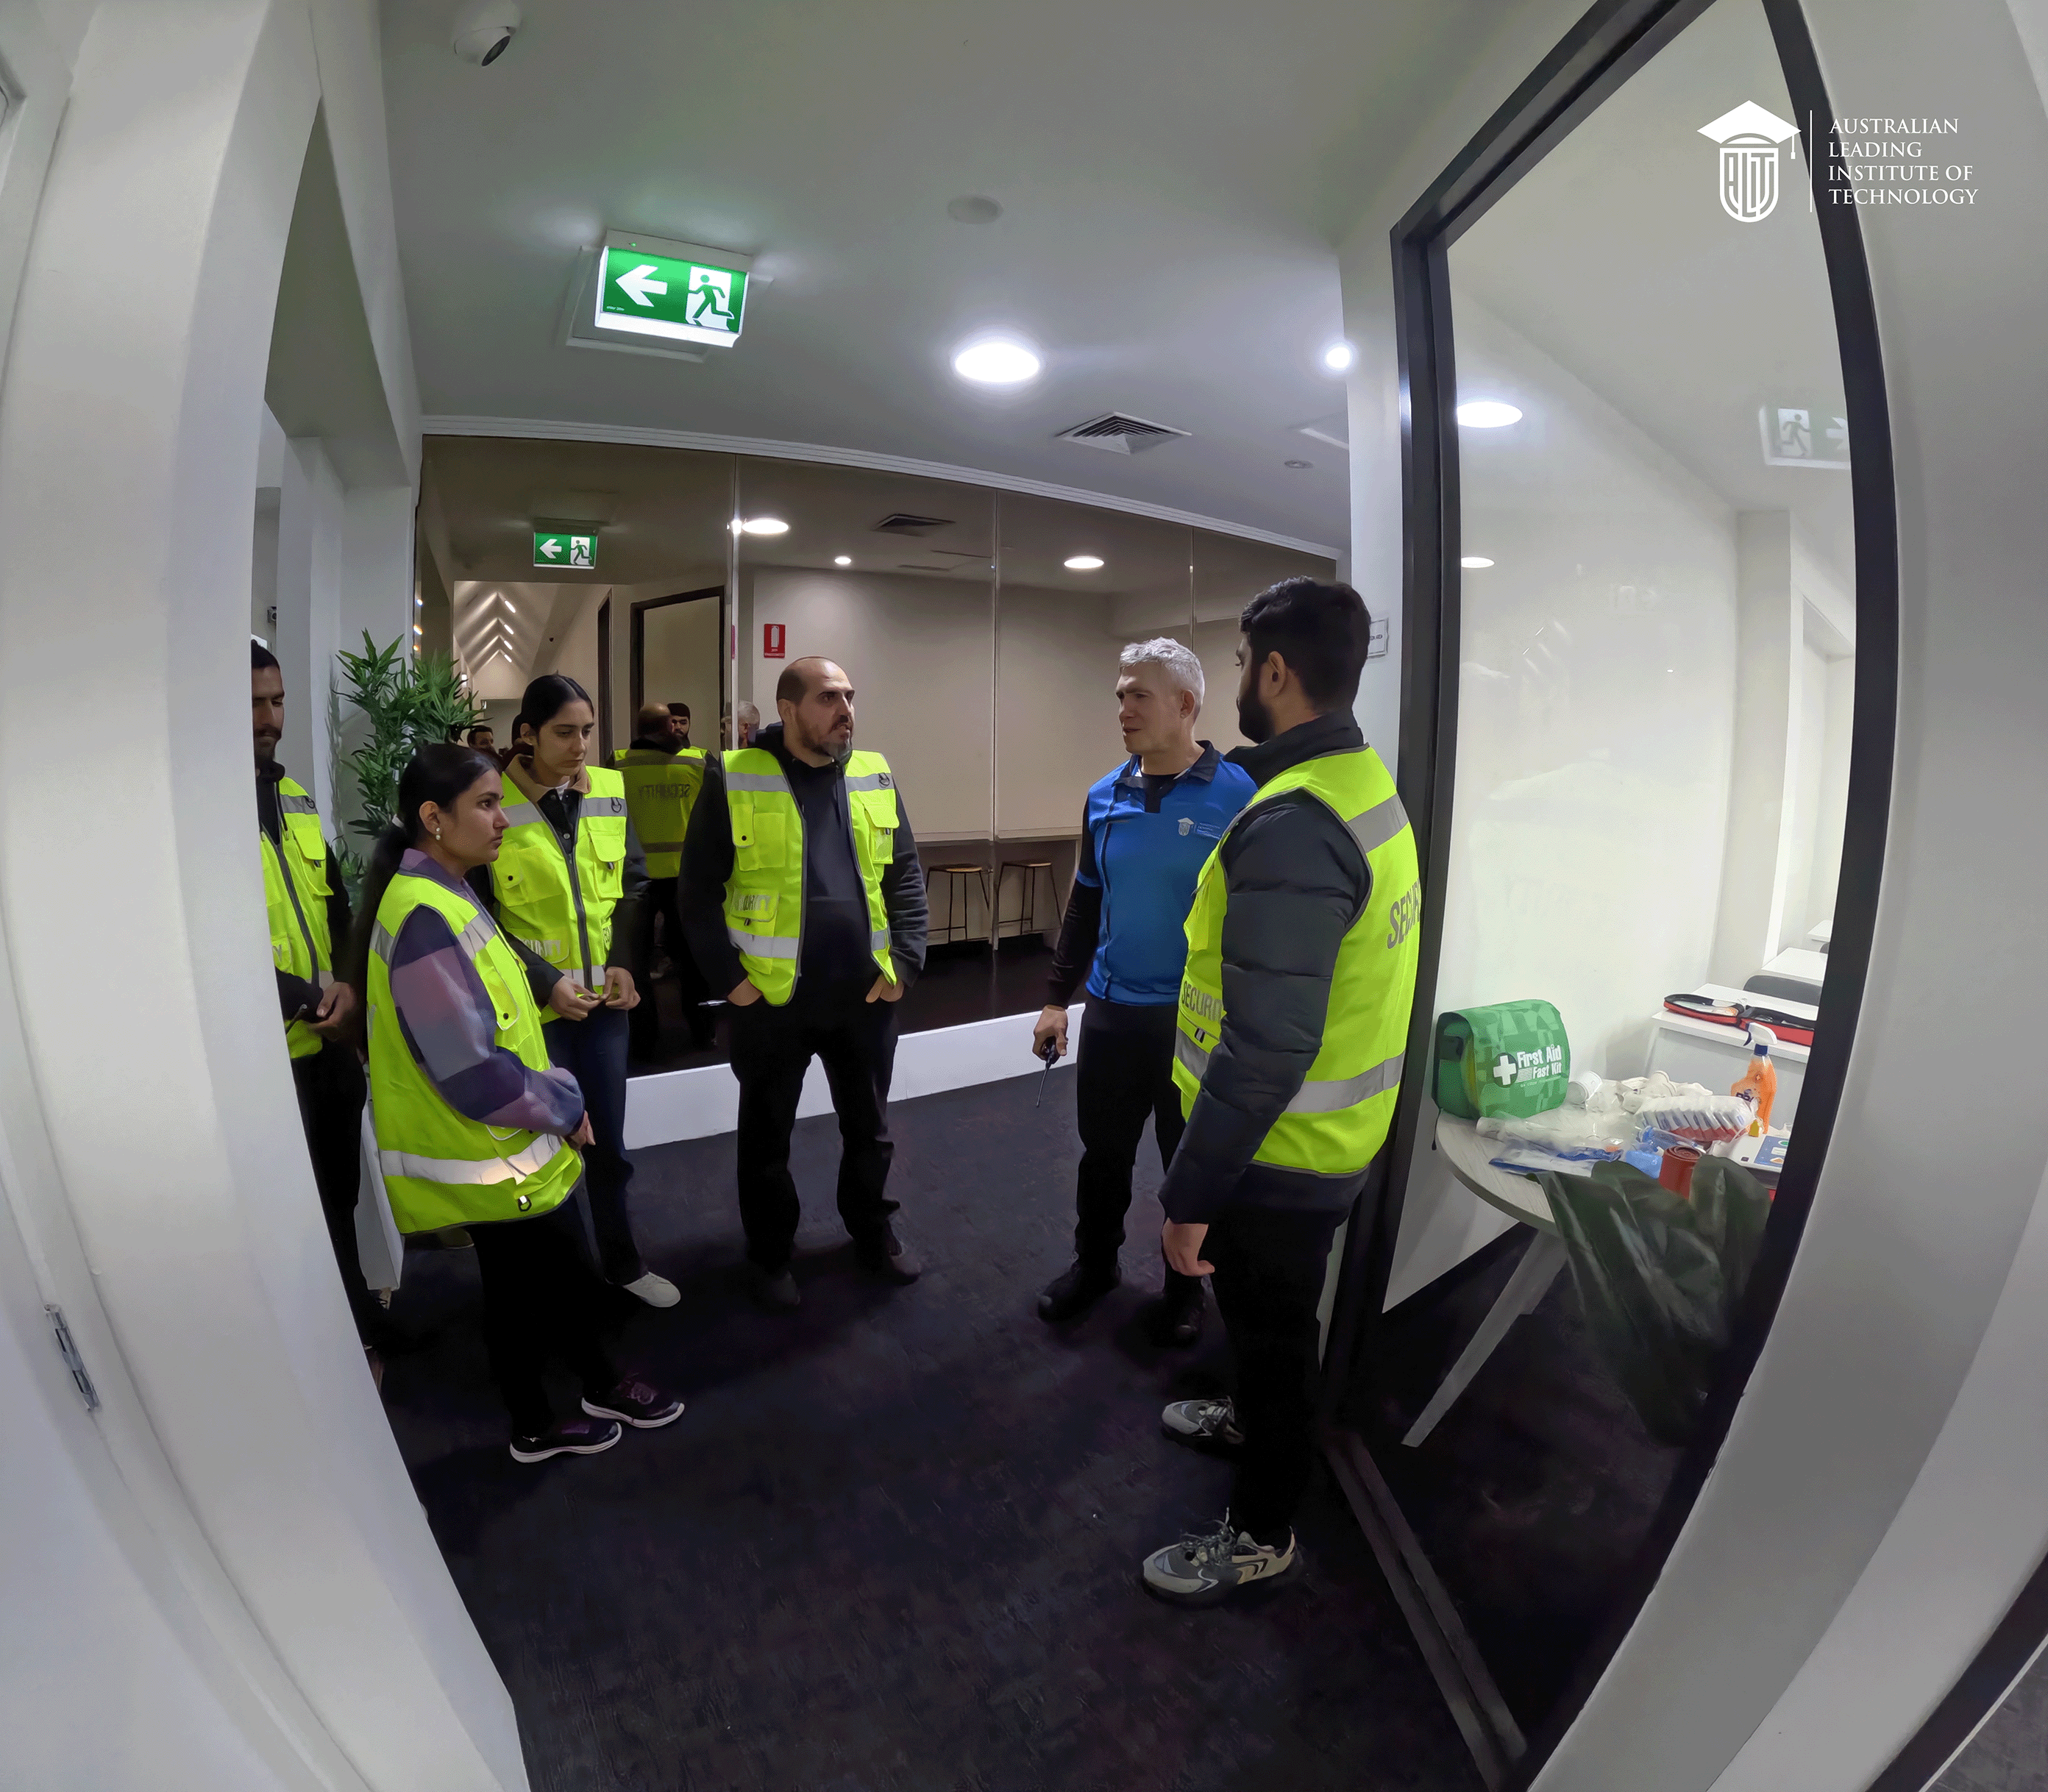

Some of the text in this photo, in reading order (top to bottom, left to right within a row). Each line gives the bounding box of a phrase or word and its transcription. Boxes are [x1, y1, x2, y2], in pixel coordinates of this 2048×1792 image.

[1516, 1043, 1562, 1069] First Aid
[1532, 1061, 1562, 1080] Fast Kit
